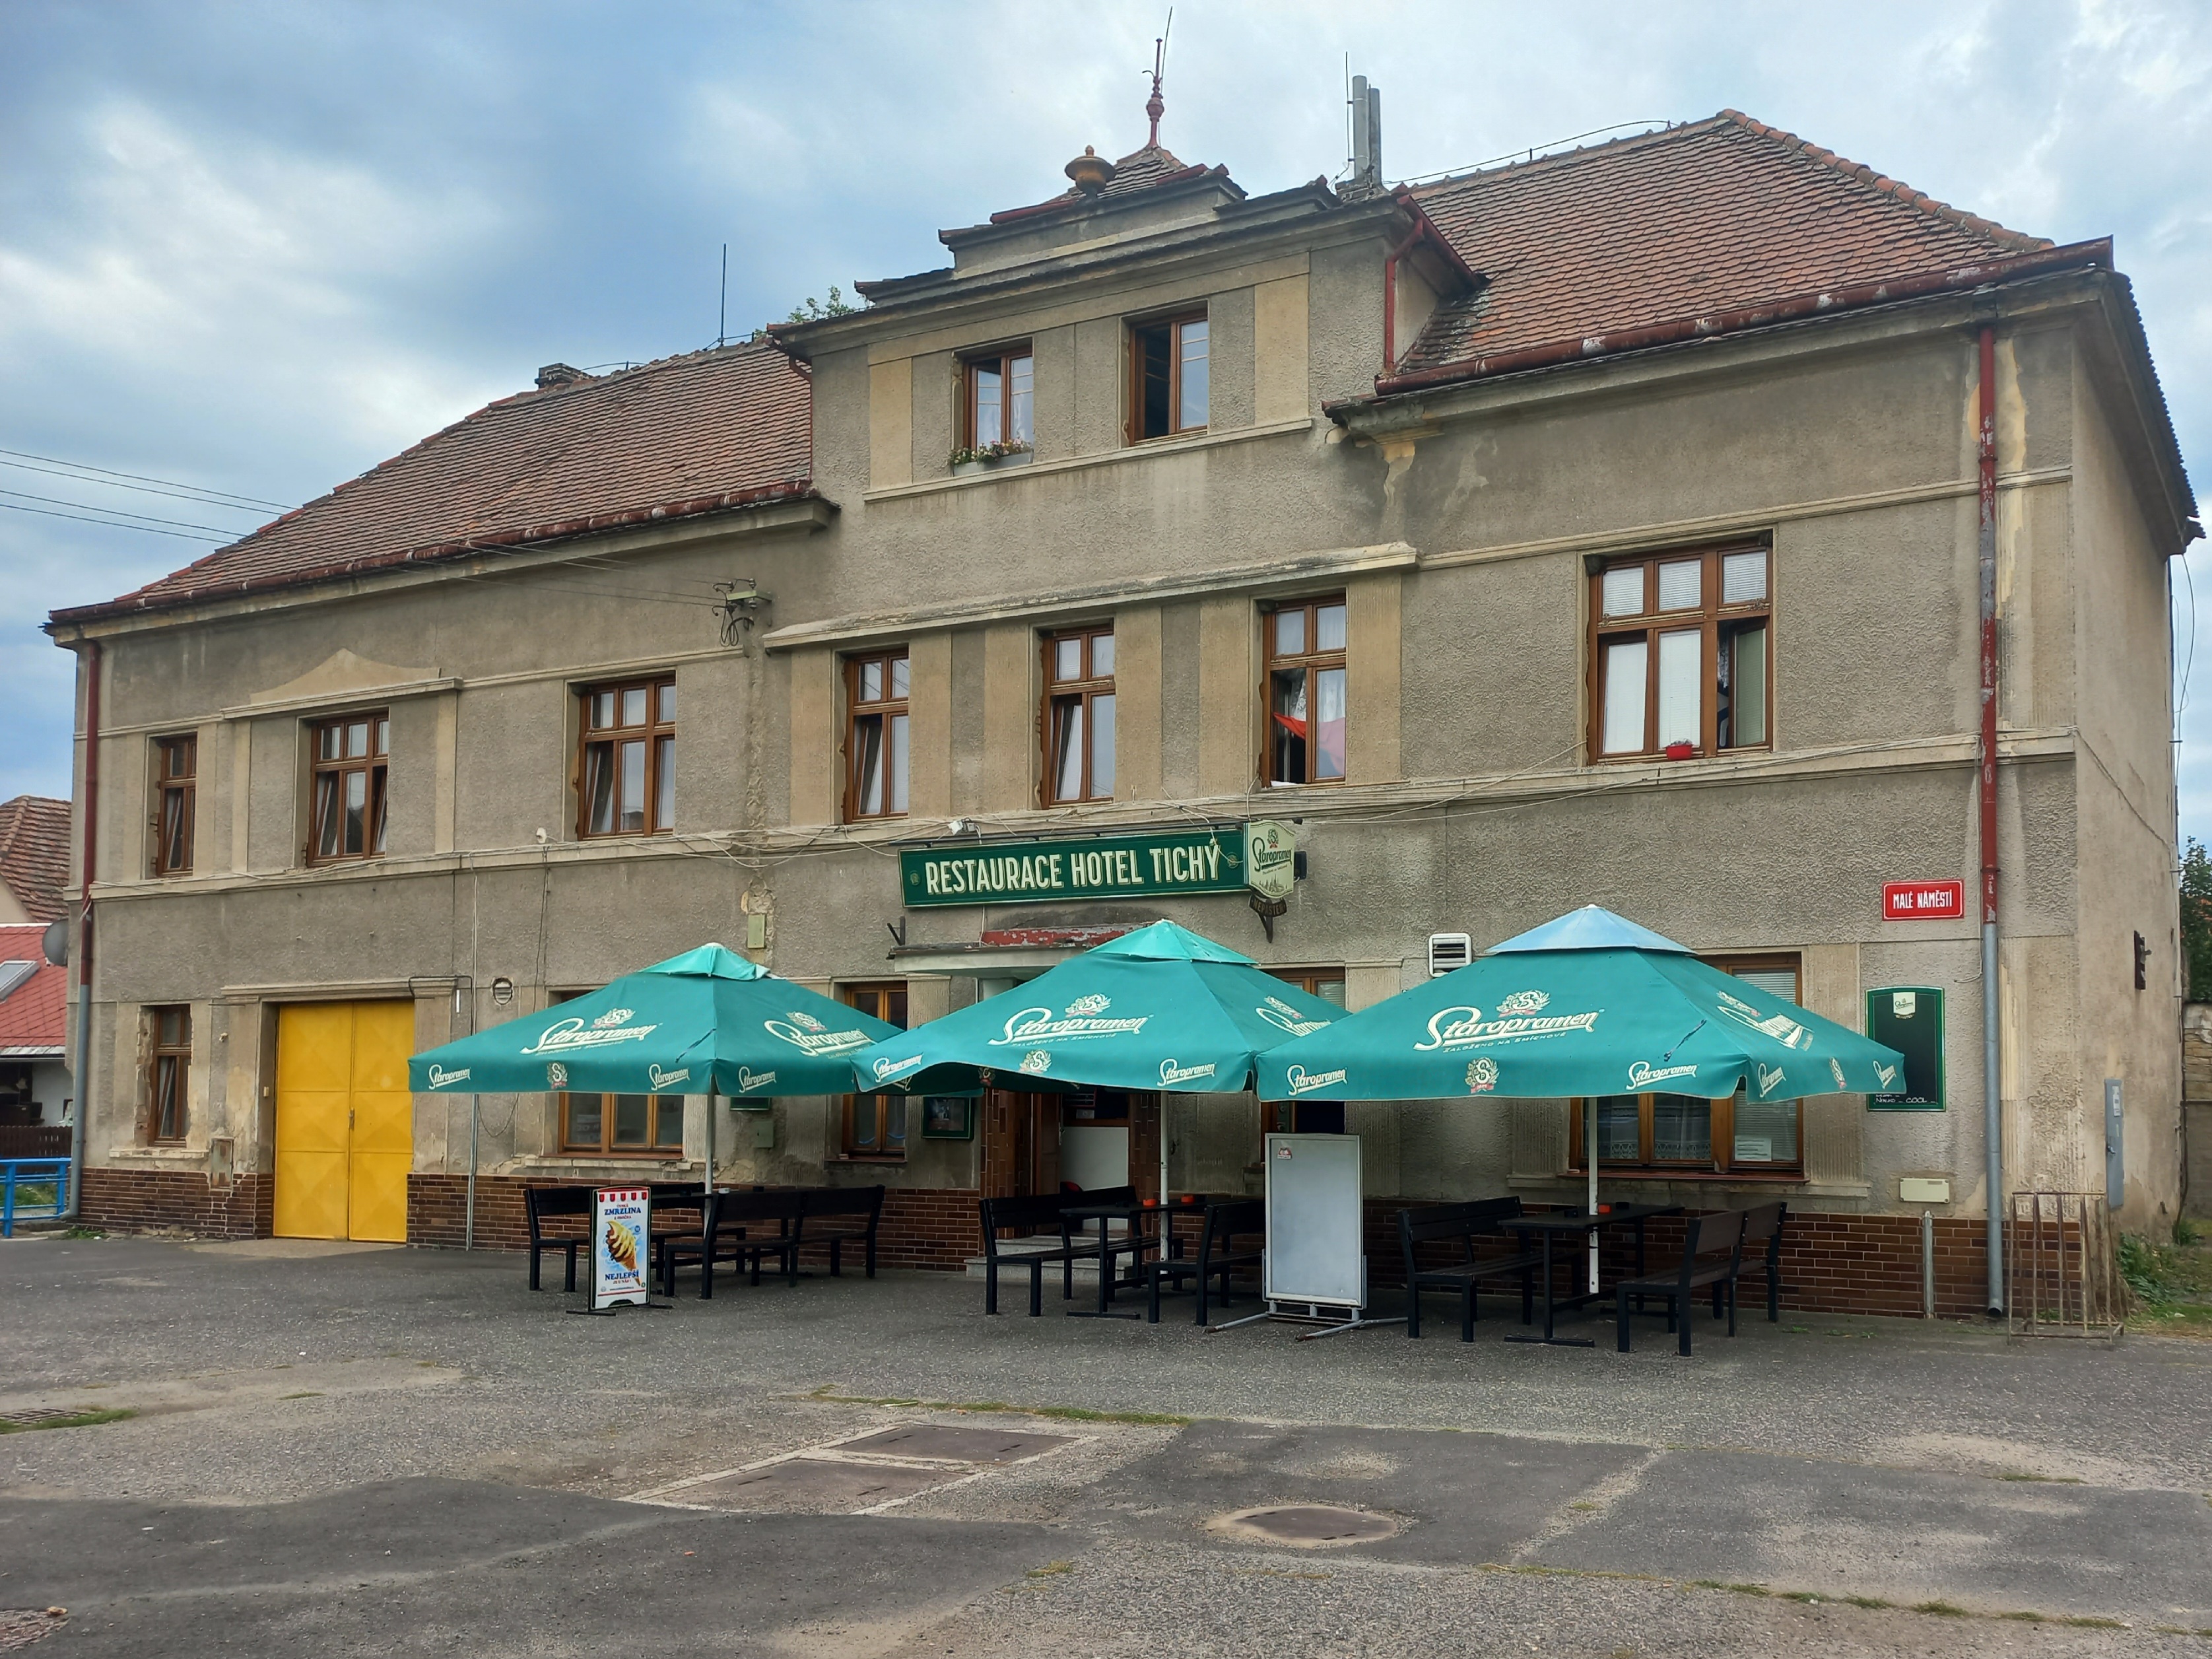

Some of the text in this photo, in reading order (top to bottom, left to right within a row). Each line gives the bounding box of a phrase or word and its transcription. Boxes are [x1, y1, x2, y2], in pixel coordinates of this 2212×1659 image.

[1252, 837, 1292, 872] Staropramen
[925, 854, 1064, 895] RESTAURACE
[1071, 850, 1144, 887] HOTEL
[1893, 889, 1953, 909] MALÉ NÁMĚSTÍ
[519, 1017, 657, 1054] Staropramen
[764, 1020, 879, 1056] Staropramen
[988, 1007, 1149, 1046] Staropramen
[1413, 1006, 1599, 1051] Staropramen
[429, 1064, 471, 1090] Staropramen
[649, 1064, 690, 1091] Staropramen
[739, 1066, 777, 1093] Staropramen
[1157, 1058, 1215, 1087] Staropramen
[1287, 1064, 1348, 1096] Staropramen
[1626, 1060, 1698, 1090] Staropramen
[605, 1269, 639, 1281] NEJLEPŠÍ
